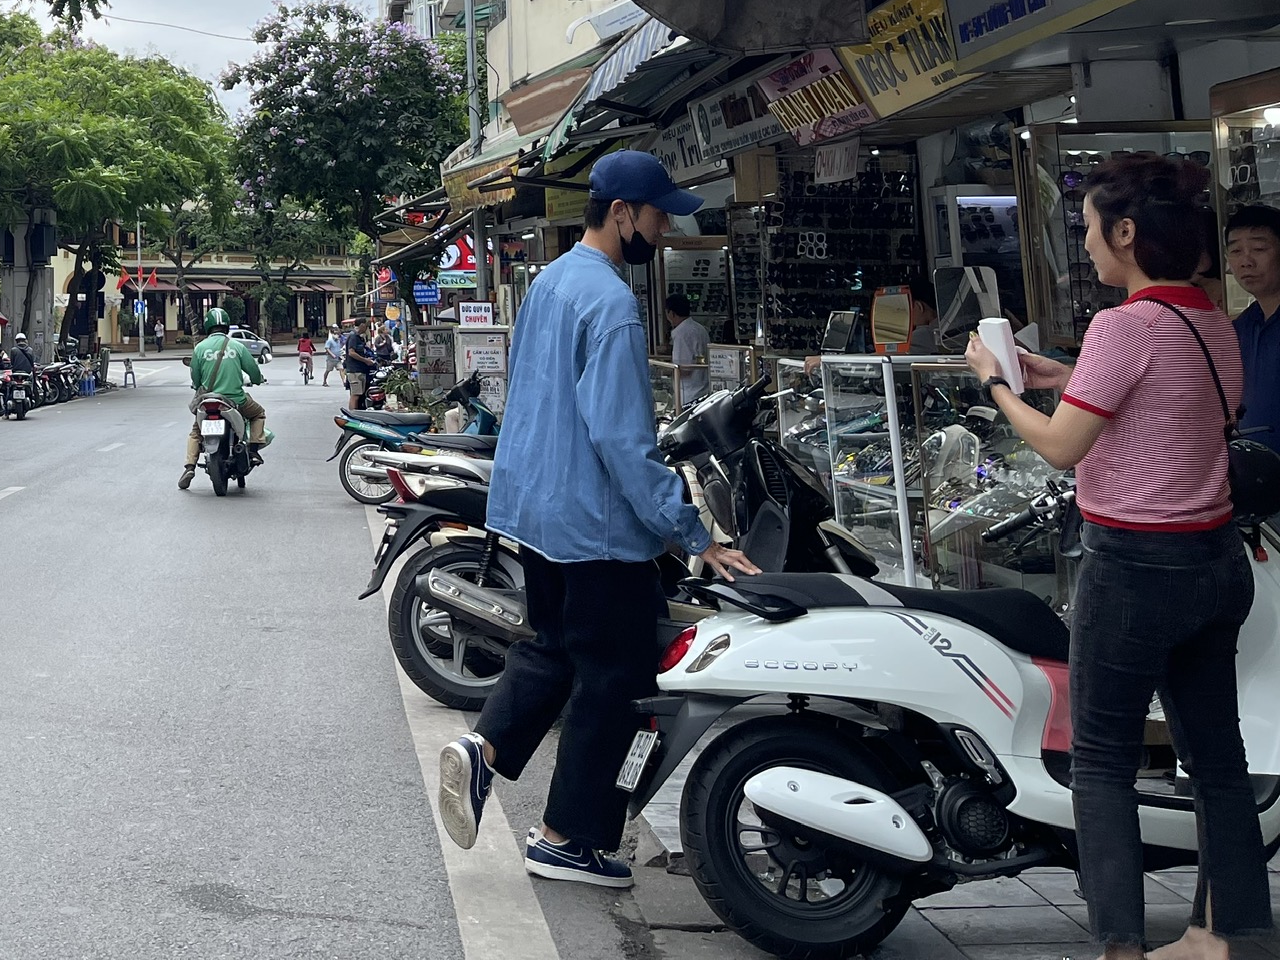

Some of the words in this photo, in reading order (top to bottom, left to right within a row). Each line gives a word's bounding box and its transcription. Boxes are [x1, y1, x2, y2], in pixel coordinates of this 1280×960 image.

[887, 2, 915, 27] KÍNH
[854, 40, 909, 97] NGỌC
[896, 12, 954, 77] THĂN
[464, 314, 488, 323] CHUYÊN
[922, 627, 938, 642] CLUB
[928, 631, 953, 655] 12
[744, 659, 858, 672] SCOOPY
